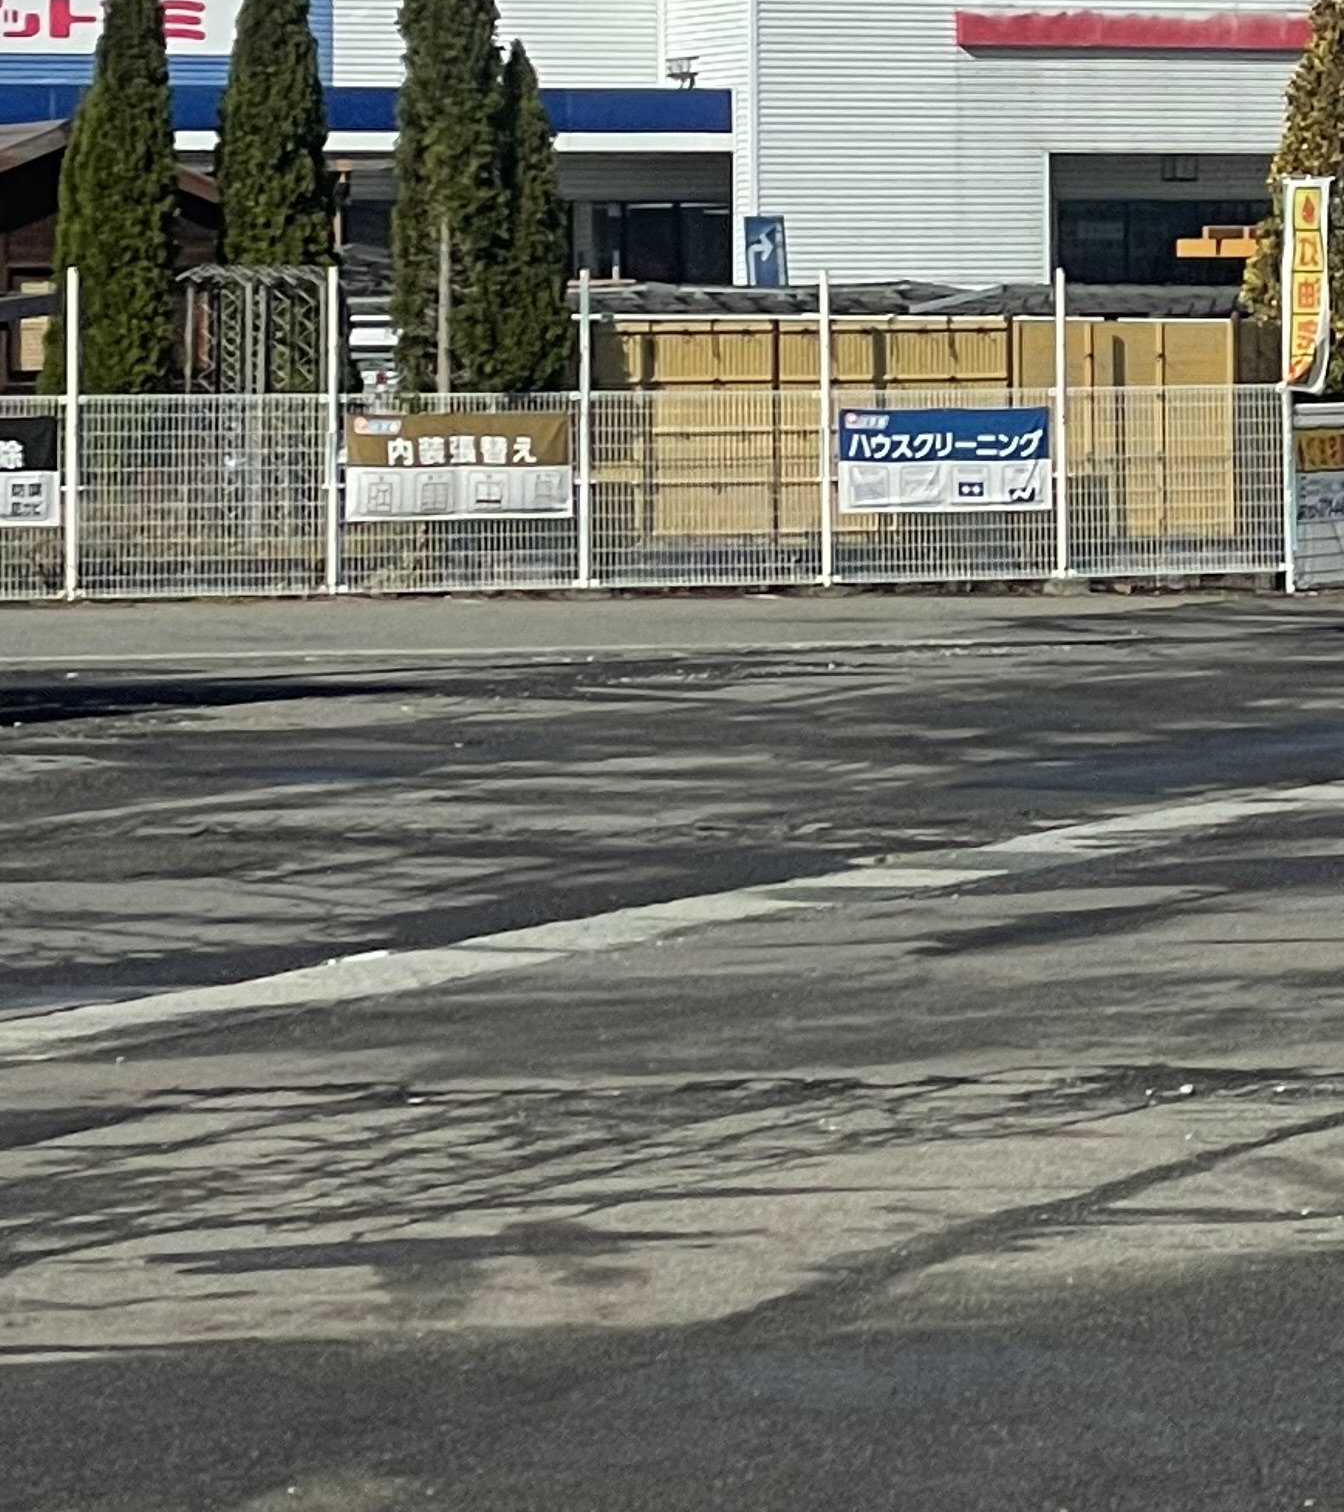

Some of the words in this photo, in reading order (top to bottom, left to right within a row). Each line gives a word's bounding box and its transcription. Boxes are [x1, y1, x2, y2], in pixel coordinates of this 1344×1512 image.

[848, 428, 1044, 459] ハウスクリーニング
